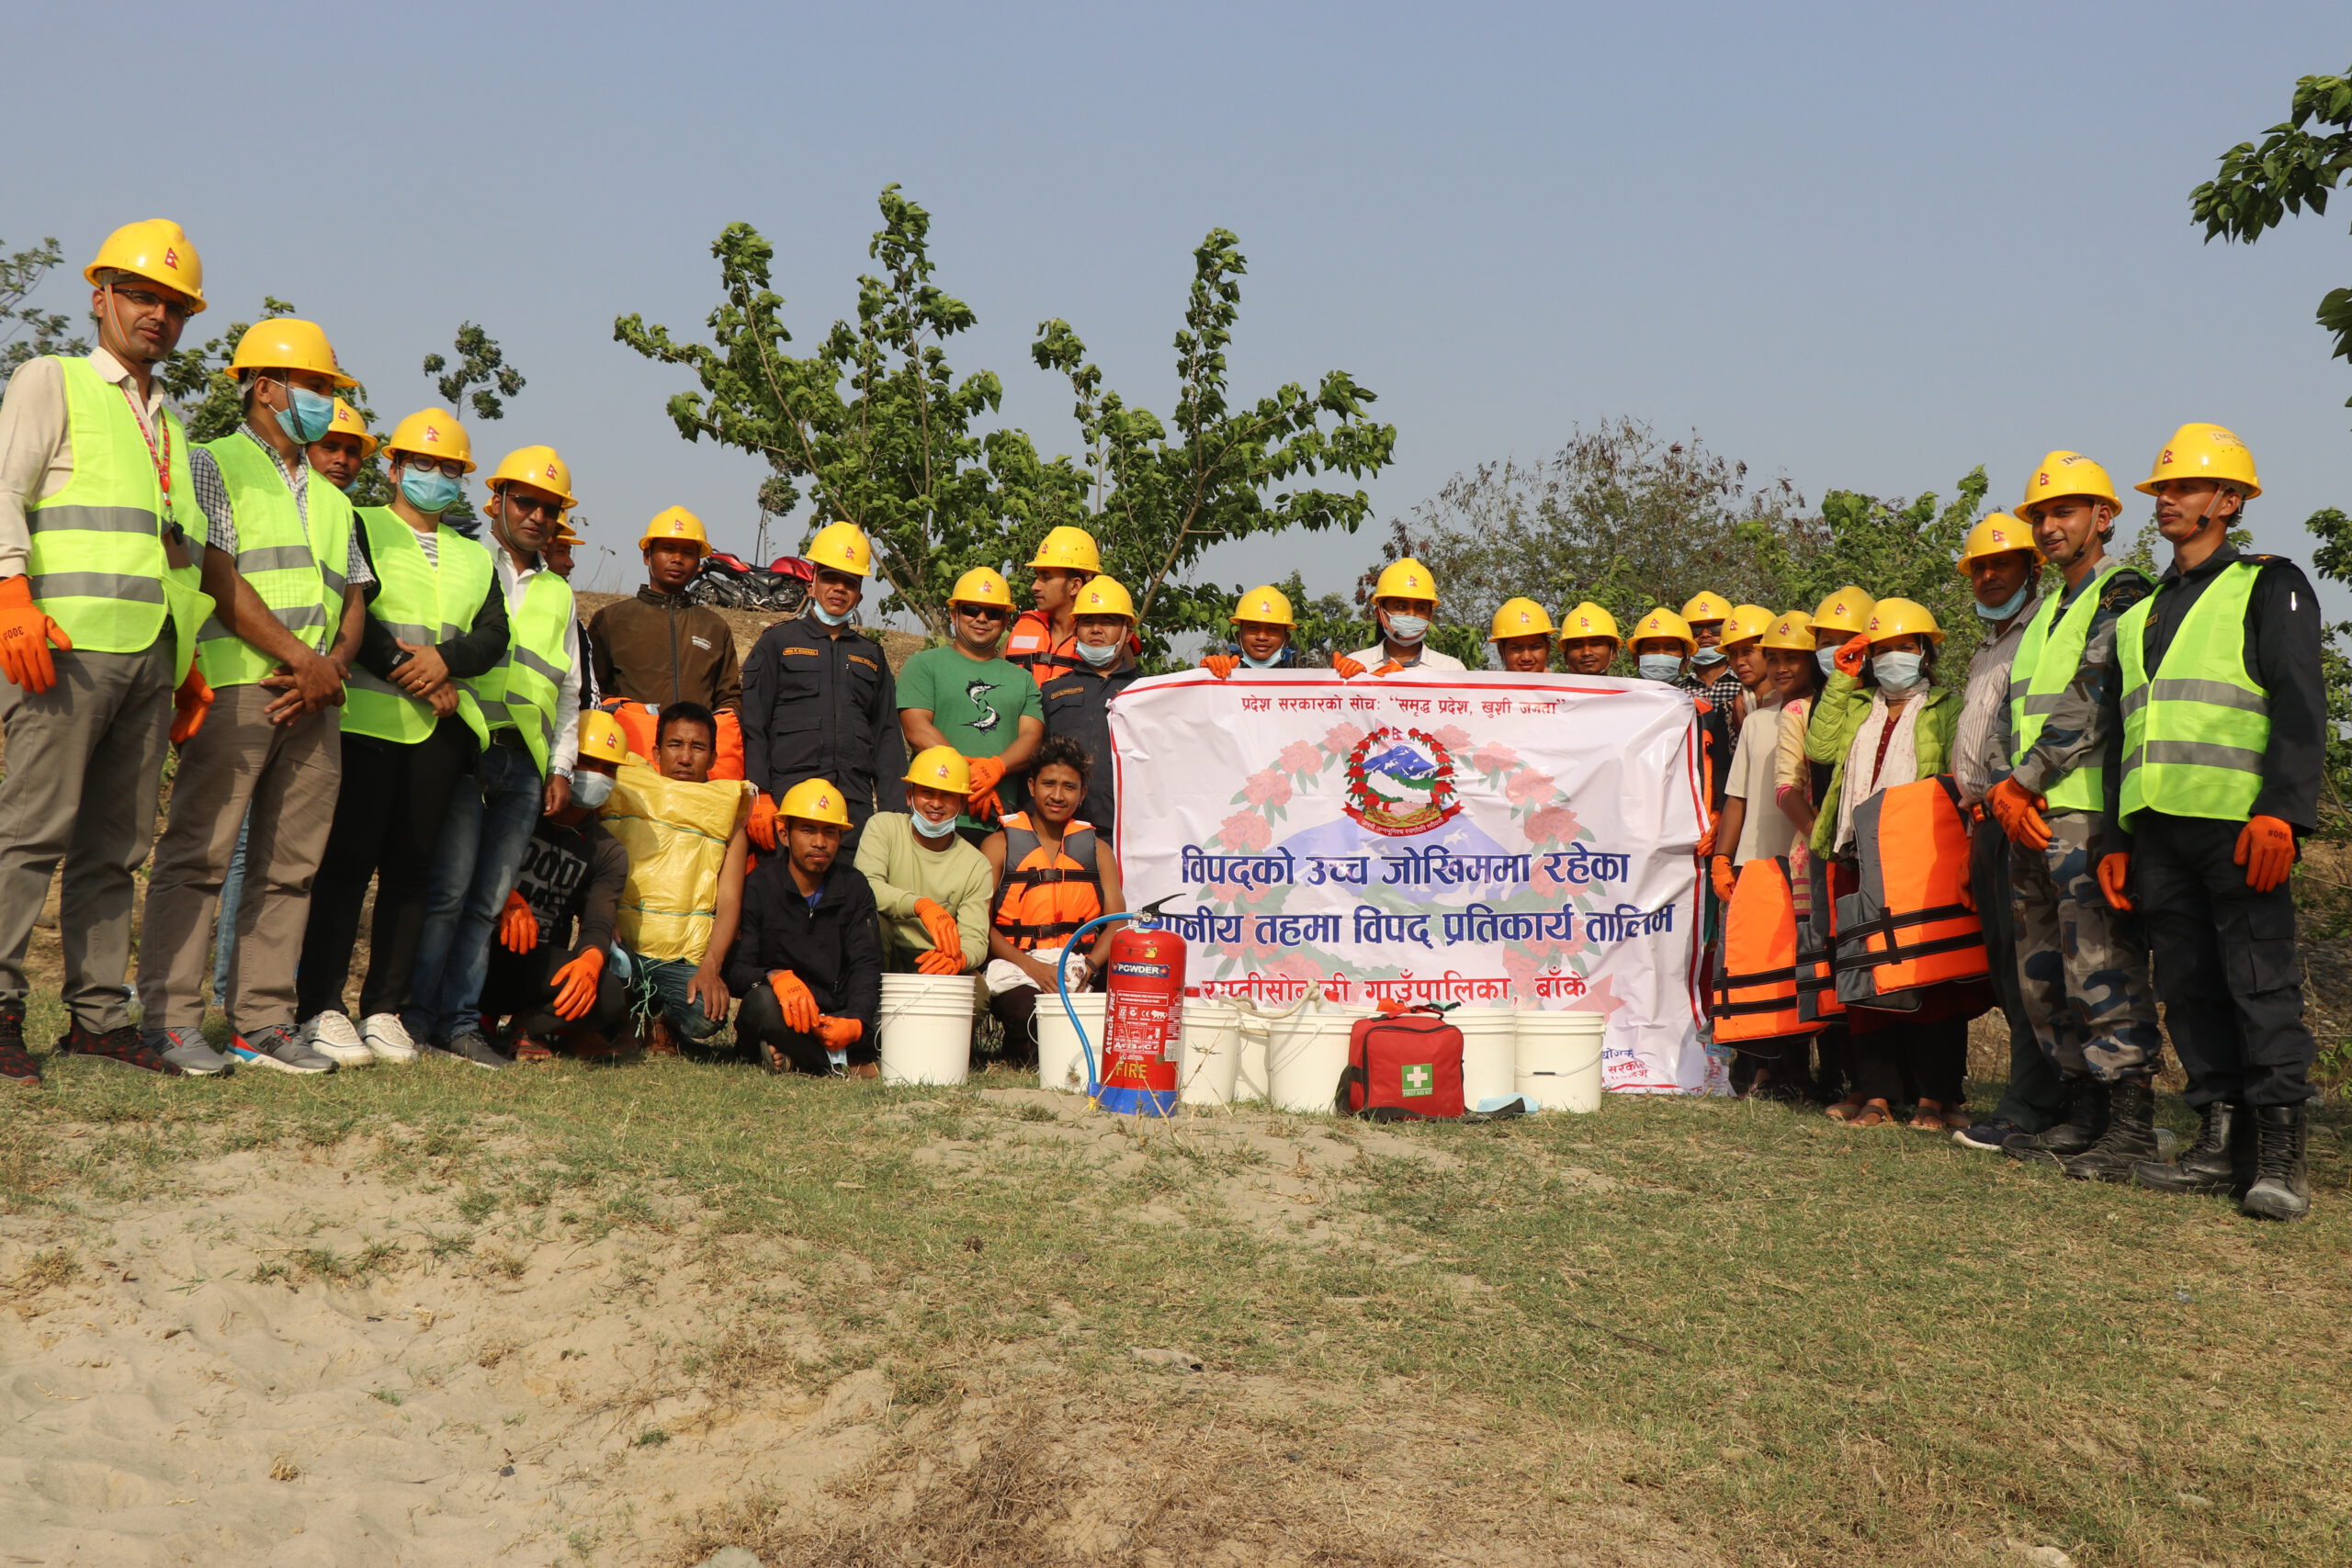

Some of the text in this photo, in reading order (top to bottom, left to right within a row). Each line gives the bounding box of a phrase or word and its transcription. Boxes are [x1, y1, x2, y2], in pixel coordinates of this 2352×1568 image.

[1241, 694, 1272, 712] प्रदेश
[1278, 694, 1342, 711] सरकारको
[1439, 697, 1473, 716] प्रदेश,
[1481, 696, 1512, 718] खुशी
[1182, 841, 1631, 891] विपद्को उच्च जोखिममा रहेका
[1255, 914, 1342, 946] तहमा
[1353, 905, 1433, 949] विपद्
[1442, 903, 1574, 946] प्रतिकार्य
[1586, 903, 1676, 943] तालिम
[1118, 964, 1159, 975] POWDER
[1363, 968, 1519, 1006] गाउँपालिका,
[1534, 965, 1589, 999] बाँके
[1105, 1015, 1114, 1055] Attack
[1115, 1062, 1148, 1079] FIRE
